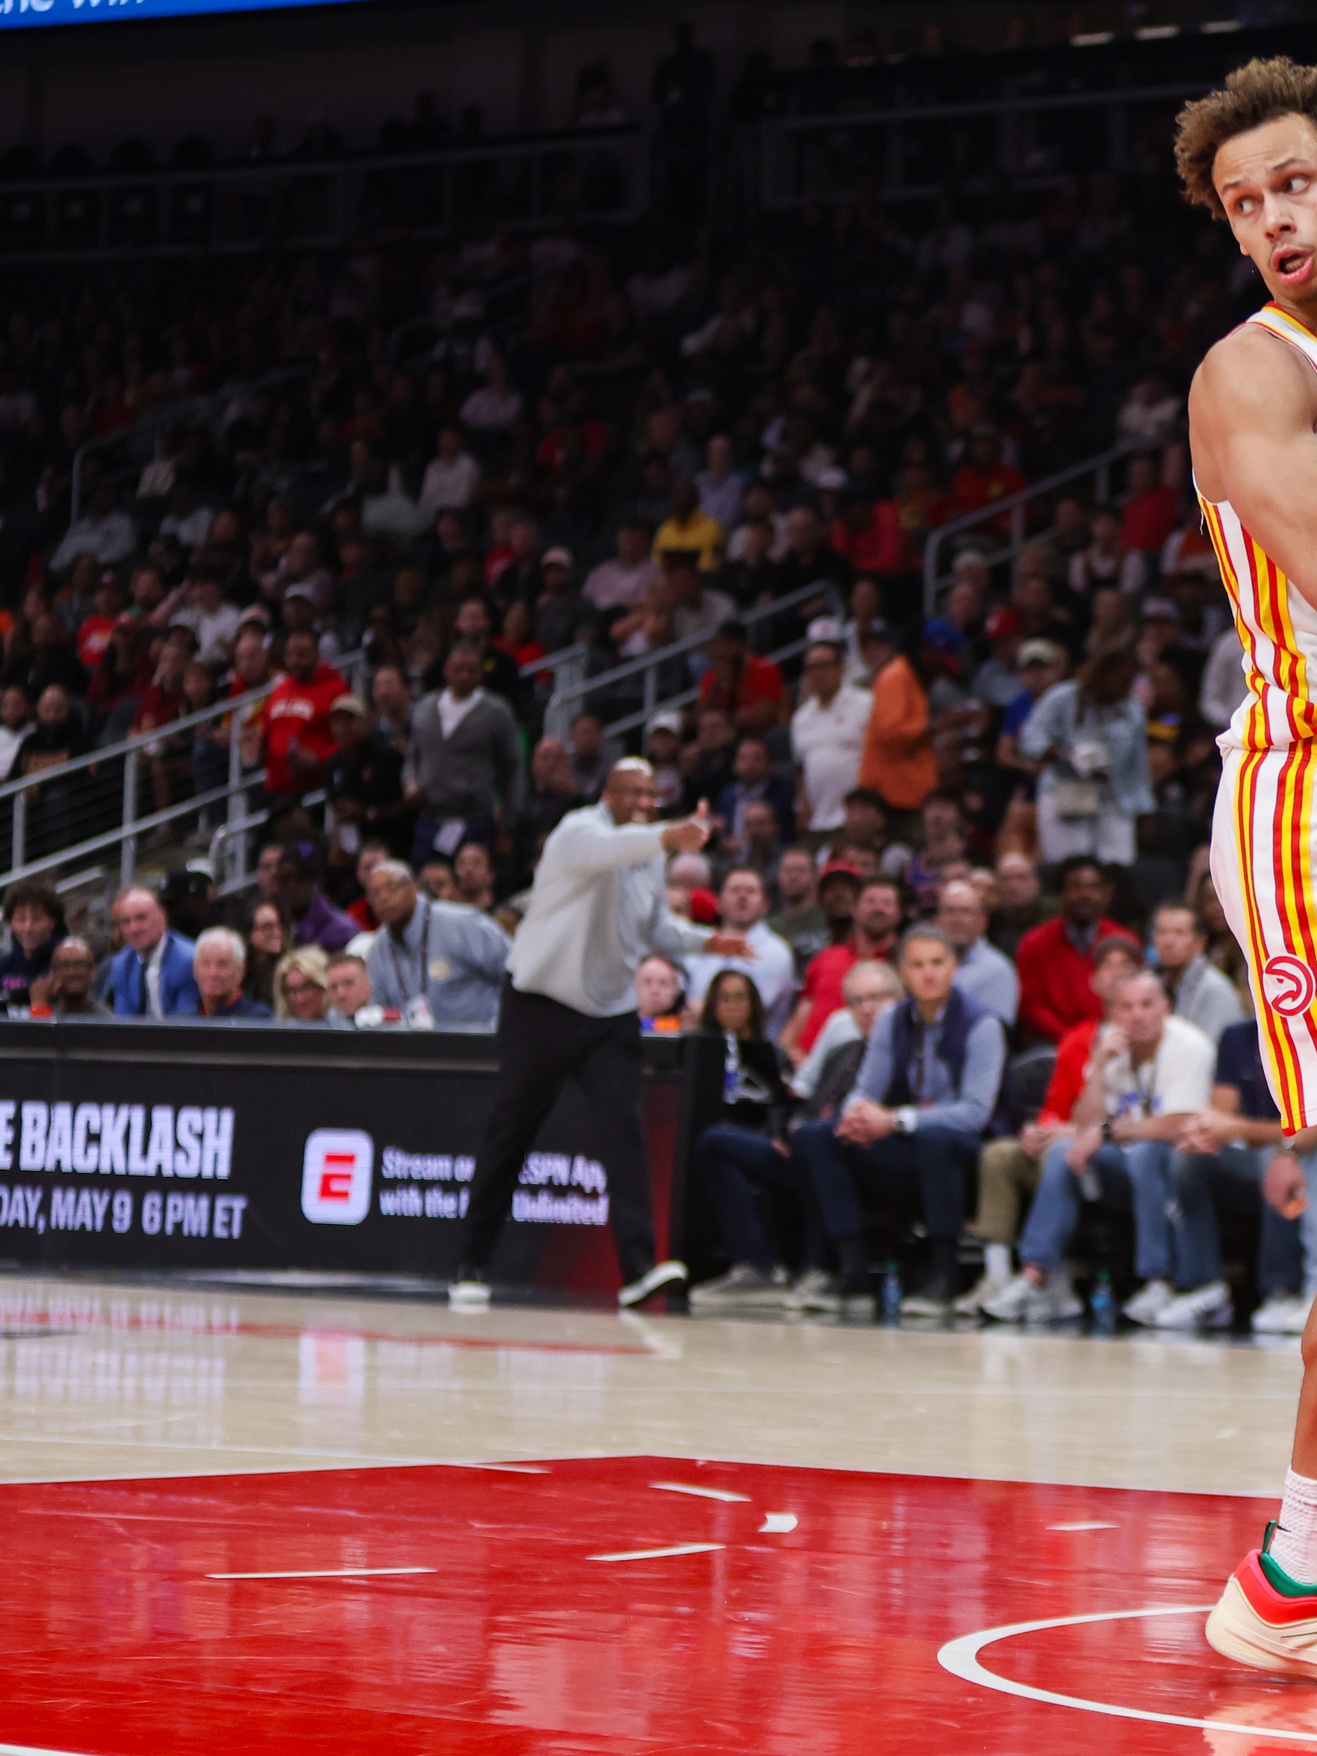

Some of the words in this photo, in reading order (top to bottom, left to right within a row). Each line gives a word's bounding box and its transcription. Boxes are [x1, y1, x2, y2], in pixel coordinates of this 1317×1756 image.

[19, 1101, 235, 1180] BACKLASH
[382, 1146, 453, 1181] Stream
[51, 1186, 110, 1233] MAY
[111, 1189, 133, 1234] 9
[379, 1184, 423, 1217] with
[425, 1184, 458, 1219] the
